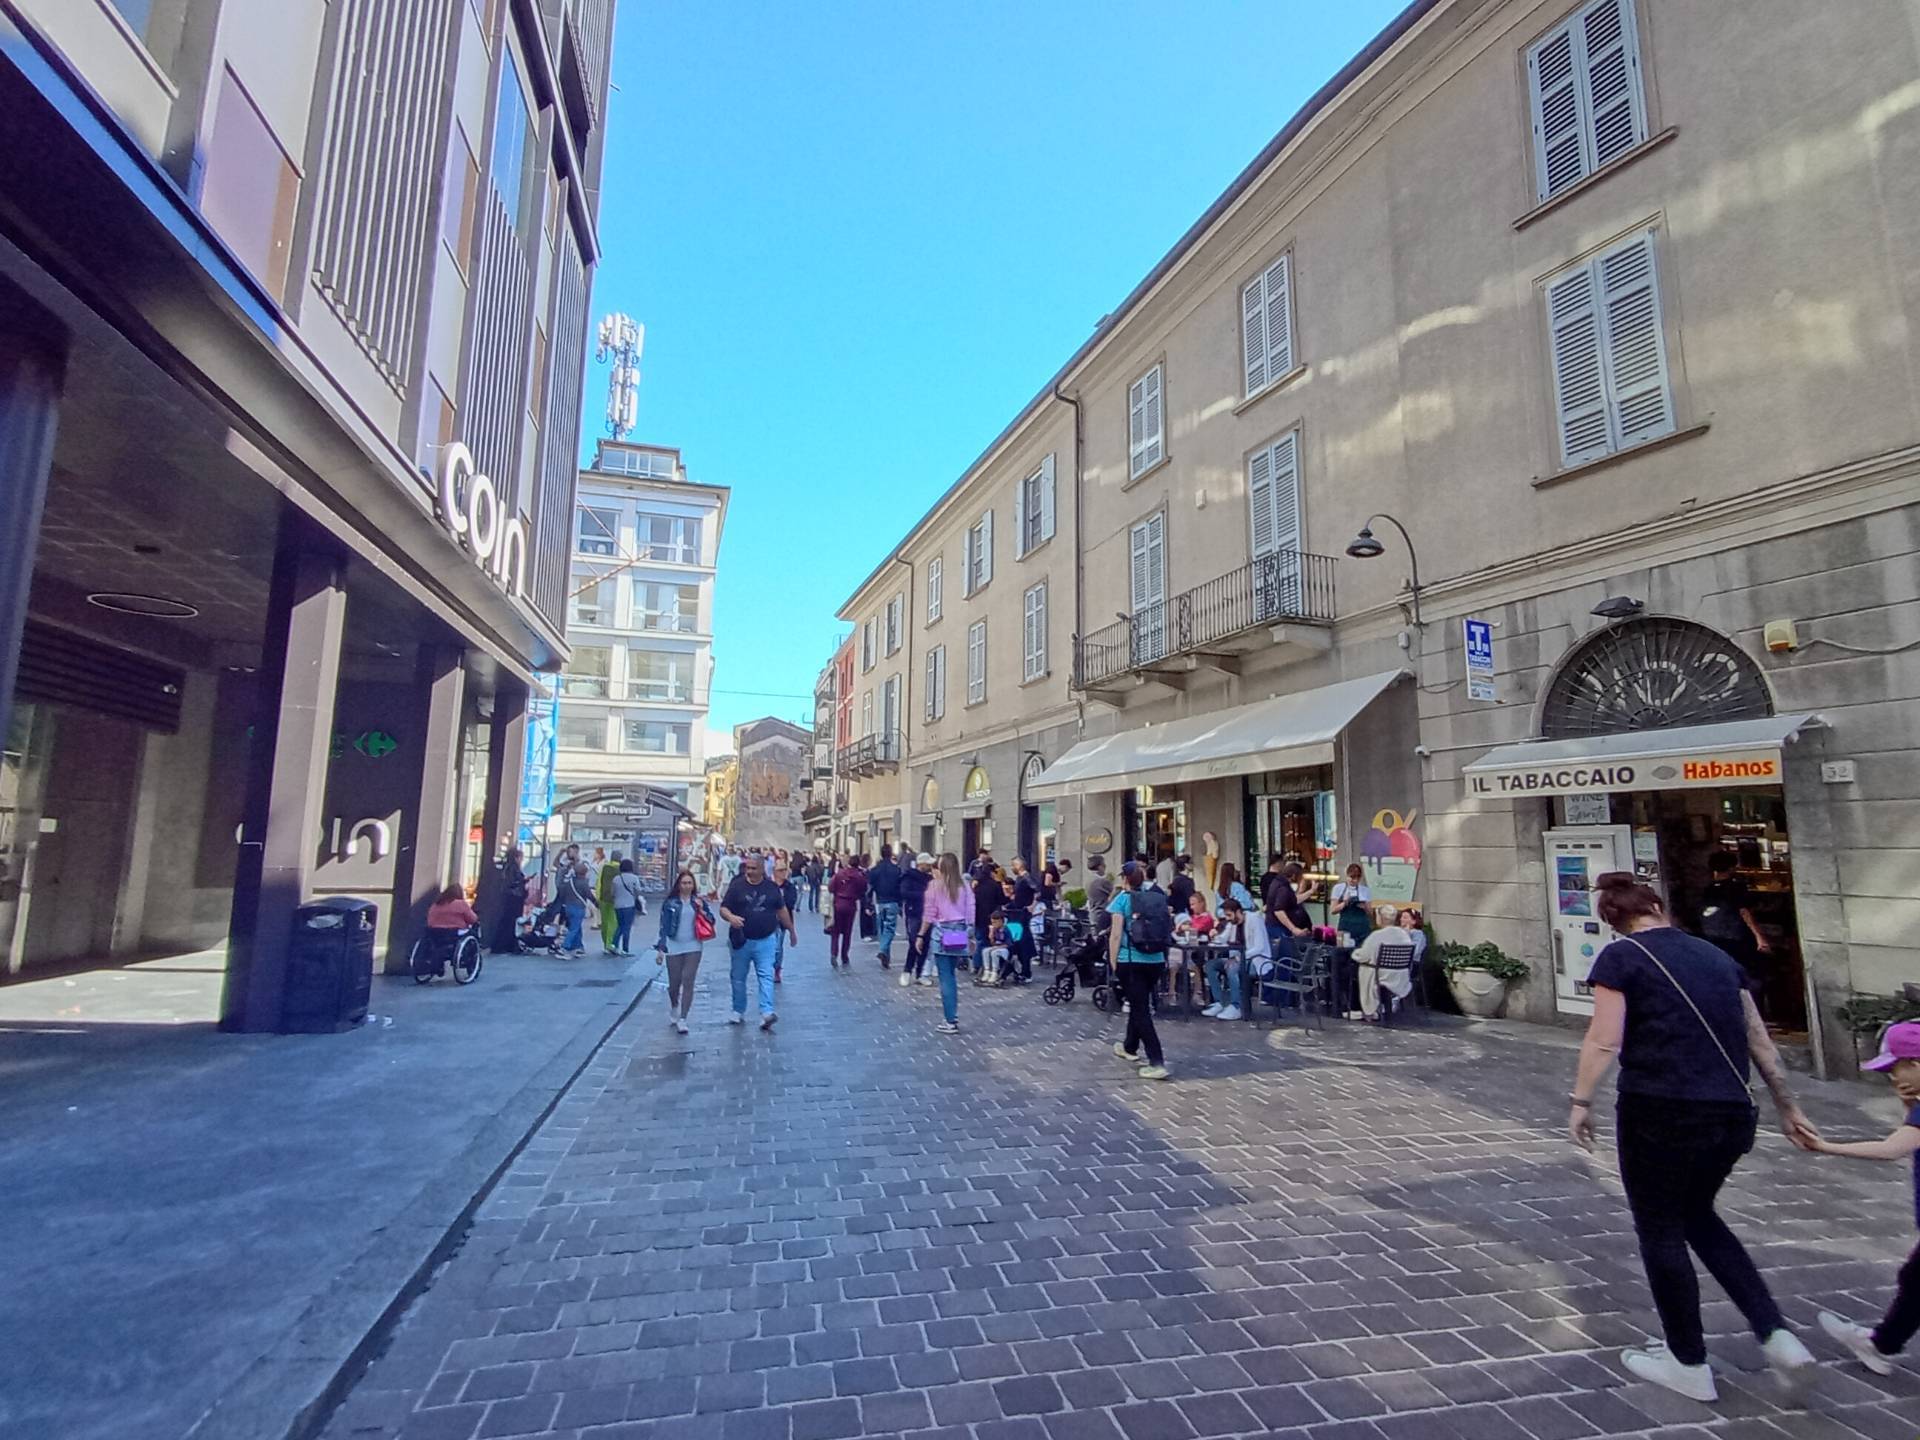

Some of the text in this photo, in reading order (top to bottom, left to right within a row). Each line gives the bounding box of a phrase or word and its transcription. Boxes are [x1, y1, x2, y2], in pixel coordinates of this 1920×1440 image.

[1471, 625, 1485, 651] T
[1473, 759, 1774, 793] IL TABACCAIO Habanos
